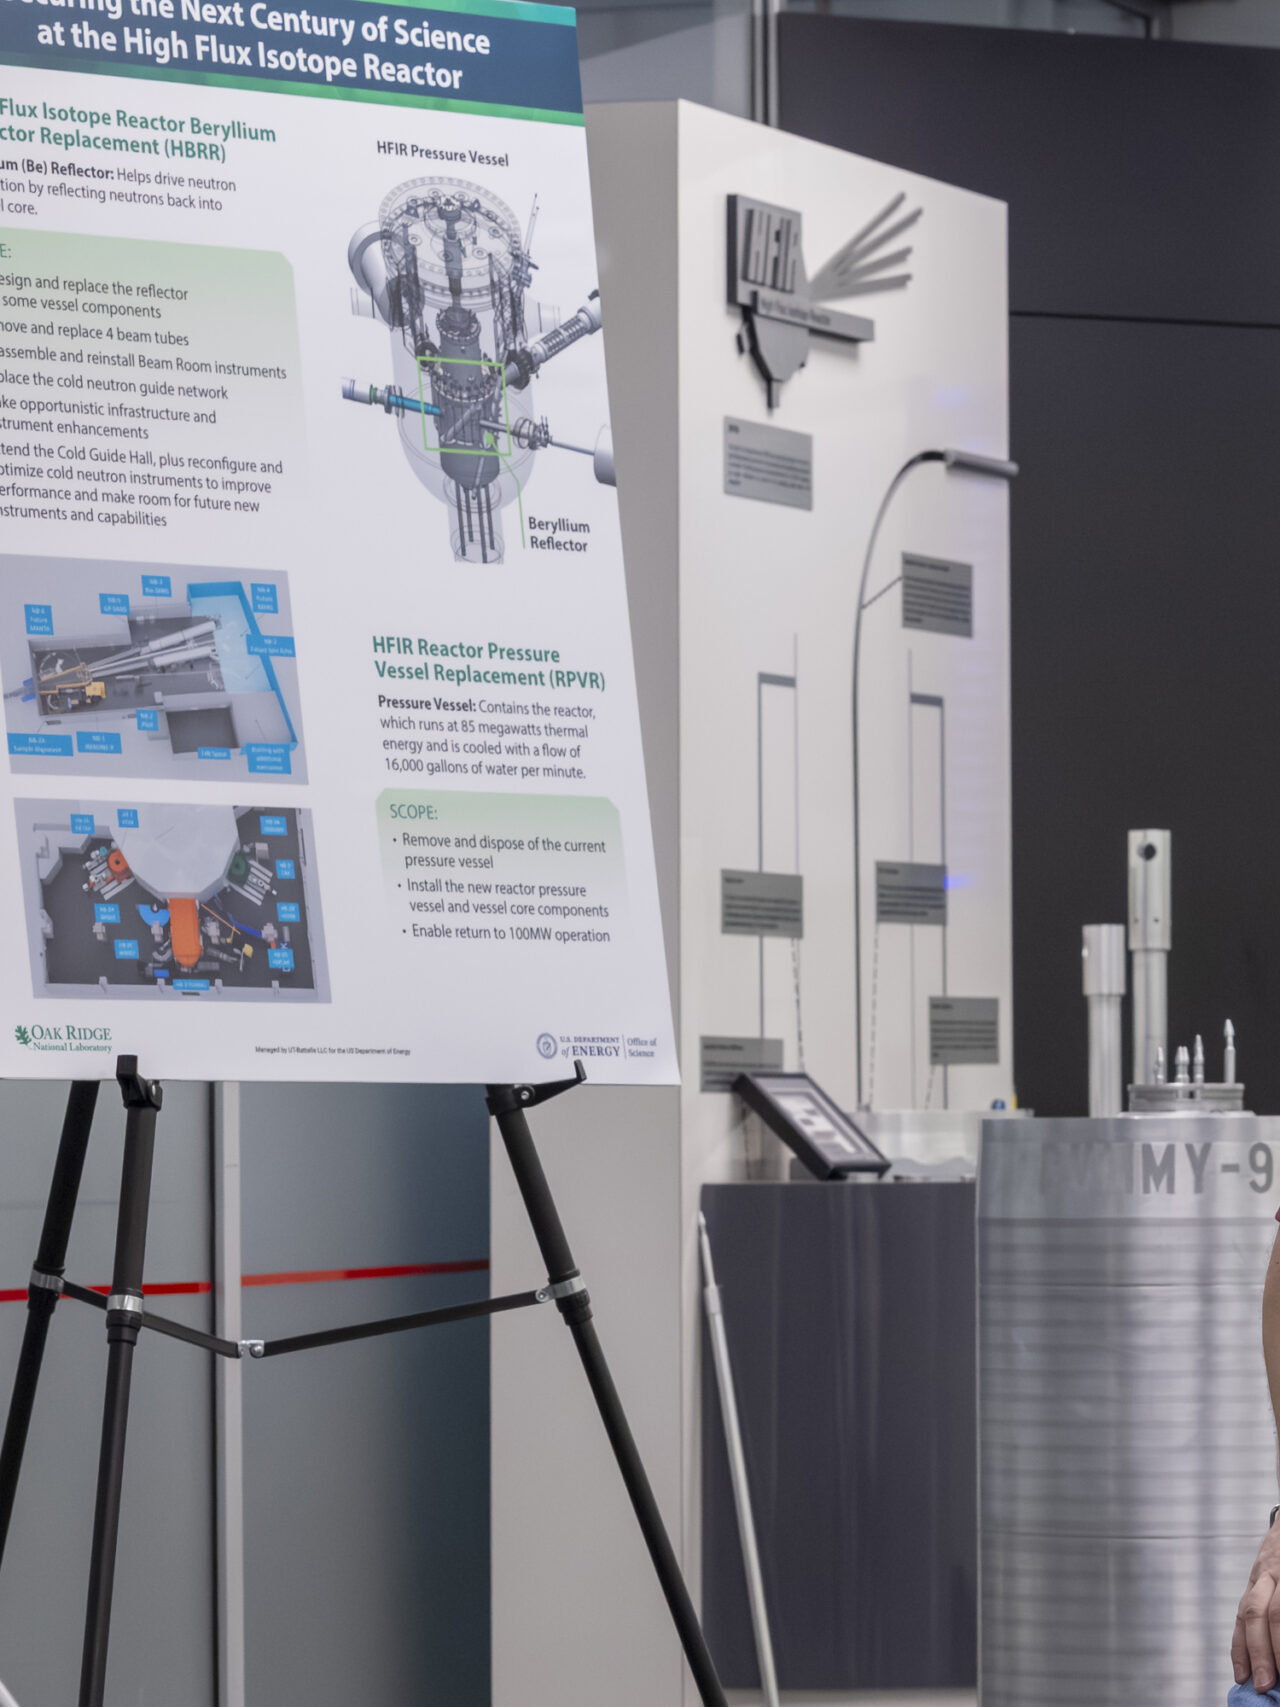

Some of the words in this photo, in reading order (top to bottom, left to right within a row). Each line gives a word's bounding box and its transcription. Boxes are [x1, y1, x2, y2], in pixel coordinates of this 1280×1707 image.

[130, 0, 174, 18] the
[180, 0, 244, 26] Next
[250, 5, 354, 44] Century
[361, 19, 388, 42] of
[393, 21, 490, 54] Science
[37, 24, 65, 46] at
[70, 26, 117, 51] the
[123, 31, 188, 63] High
[195, 39, 252, 66] Flux
[258, 45, 357, 80] Isotope
[363, 56, 461, 88] Reactor
[42, 102, 111, 128] Isotope
[116, 109, 185, 132] Reactor
[190, 117, 276, 142] Beryllium
[40, 128, 159, 154] Replacement
[164, 139, 225, 163] (HBRR)
[376, 140, 408, 156] HFIR
[410, 144, 466, 162] Pressure
[468, 150, 509, 167] Vessel
[21, 158, 47, 175] (Be)
[50, 161, 114, 179] Reflector:
[116, 167, 151, 185] Helps
[154, 171, 184, 187] drive
[188, 177, 236, 191] neutron
[7, 202, 38, 215] core.
[47, 182, 106, 203] reflecting
[109, 190, 164, 205] neutrons
[166, 192, 196, 208] back
[198, 195, 222, 211] into
[35, 275, 59, 290] and
[62, 278, 109, 295] replace
[111, 280, 133, 296] the
[136, 283, 188, 300] reflector
[2, 295, 37, 308] some
[40, 298, 78, 312] vessel
[81, 302, 161, 318] components
[30, 321, 54, 335] and
[57, 323, 103, 340] replace
[105, 327, 113, 340] 4
[116, 326, 152, 343] beam
[154, 330, 189, 346] tubes
[59, 349, 83, 363] and
[86, 351, 135, 367] reinstall
[138, 354, 173, 370] Beam
[175, 357, 212, 373] Room
[214, 360, 286, 379] instruments
[32, 371, 54, 387] the
[56, 374, 83, 389] cold
[86, 378, 136, 392] neutron
[139, 380, 174, 397] guide
[177, 385, 228, 399] network
[19, 399, 104, 415] opportunistic
[107, 402, 190, 422] infrastructure
[193, 410, 216, 424] and
[56, 420, 149, 439] enhancements
[33, 443, 54, 458] the
[57, 445, 86, 460] Cold
[88, 447, 126, 463] Guide
[128, 450, 156, 467] Hall,
[158, 452, 185, 469] plus
[187, 456, 256, 474] reconfigure
[260, 460, 283, 474] and
[46, 465, 73, 480] cold
[76, 469, 127, 483] neutron
[129, 470, 203, 488] instruments
[205, 476, 219, 490] to
[221, 477, 271, 494] improve
[74, 487, 98, 502] and
[101, 489, 135, 504] make
[138, 494, 171, 506] room
[173, 492, 191, 507] for
[193, 494, 231, 511] future
[233, 500, 260, 512] new
[70, 508, 94, 522] and
[97, 510, 167, 526] capabilities
[528, 516, 590, 534] Beryllium
[530, 535, 587, 552] Reflector
[372, 636, 413, 655] HFIR
[417, 638, 483, 658] Reactor
[487, 642, 560, 663] Pressure
[374, 660, 429, 680] Vessel
[433, 663, 545, 686] Replacement
[549, 669, 605, 691] (RPVR)
[377, 694, 431, 710] Pressure
[433, 697, 476, 712] Vessel:
[478, 699, 529, 715] Contains
[531, 702, 551, 716] the
[553, 705, 595, 719] reactor,
[379, 715, 416, 730] which
[418, 720, 444, 732] runs
[446, 719, 459, 732] at
[460, 719, 475, 733] 85
[478, 722, 542, 737] megawatts
[543, 722, 588, 738] thermal
[382, 739, 423, 754] energy
[426, 738, 448, 752] and
[462, 740, 502, 755] cooled
[504, 742, 530, 756] with
[541, 742, 567, 757] flow
[385, 757, 424, 772] 16,000
[426, 759, 468, 776] gallons
[470, 760, 483, 774] of
[484, 763, 518, 776] water
[520, 765, 540, 779] per
[542, 764, 586, 779] minute.
[389, 803, 438, 820] SCOPE:
[402, 832, 451, 848] Remove
[454, 834, 477, 849] and
[479, 834, 524, 852] dispose
[527, 836, 539, 851] of
[541, 837, 561, 852] the
[563, 841, 606, 853] current
[404, 855, 455, 869] pressure
[457, 855, 494, 869] vessel
[407, 877, 442, 892] Install
[444, 878, 464, 893] the
[467, 883, 492, 894] new
[494, 882, 535, 895] reactor
[538, 885, 586, 898] pressure
[409, 898, 445, 912] vessel
[447, 899, 470, 913] and
[472, 900, 507, 914] vessel
[509, 903, 535, 915] core
[537, 904, 609, 918] components
[411, 923, 452, 938] Enable
[454, 926, 491, 939] return
[493, 927, 506, 940] to
[509, 926, 552, 940] 100MW
[554, 928, 610, 944] operation
